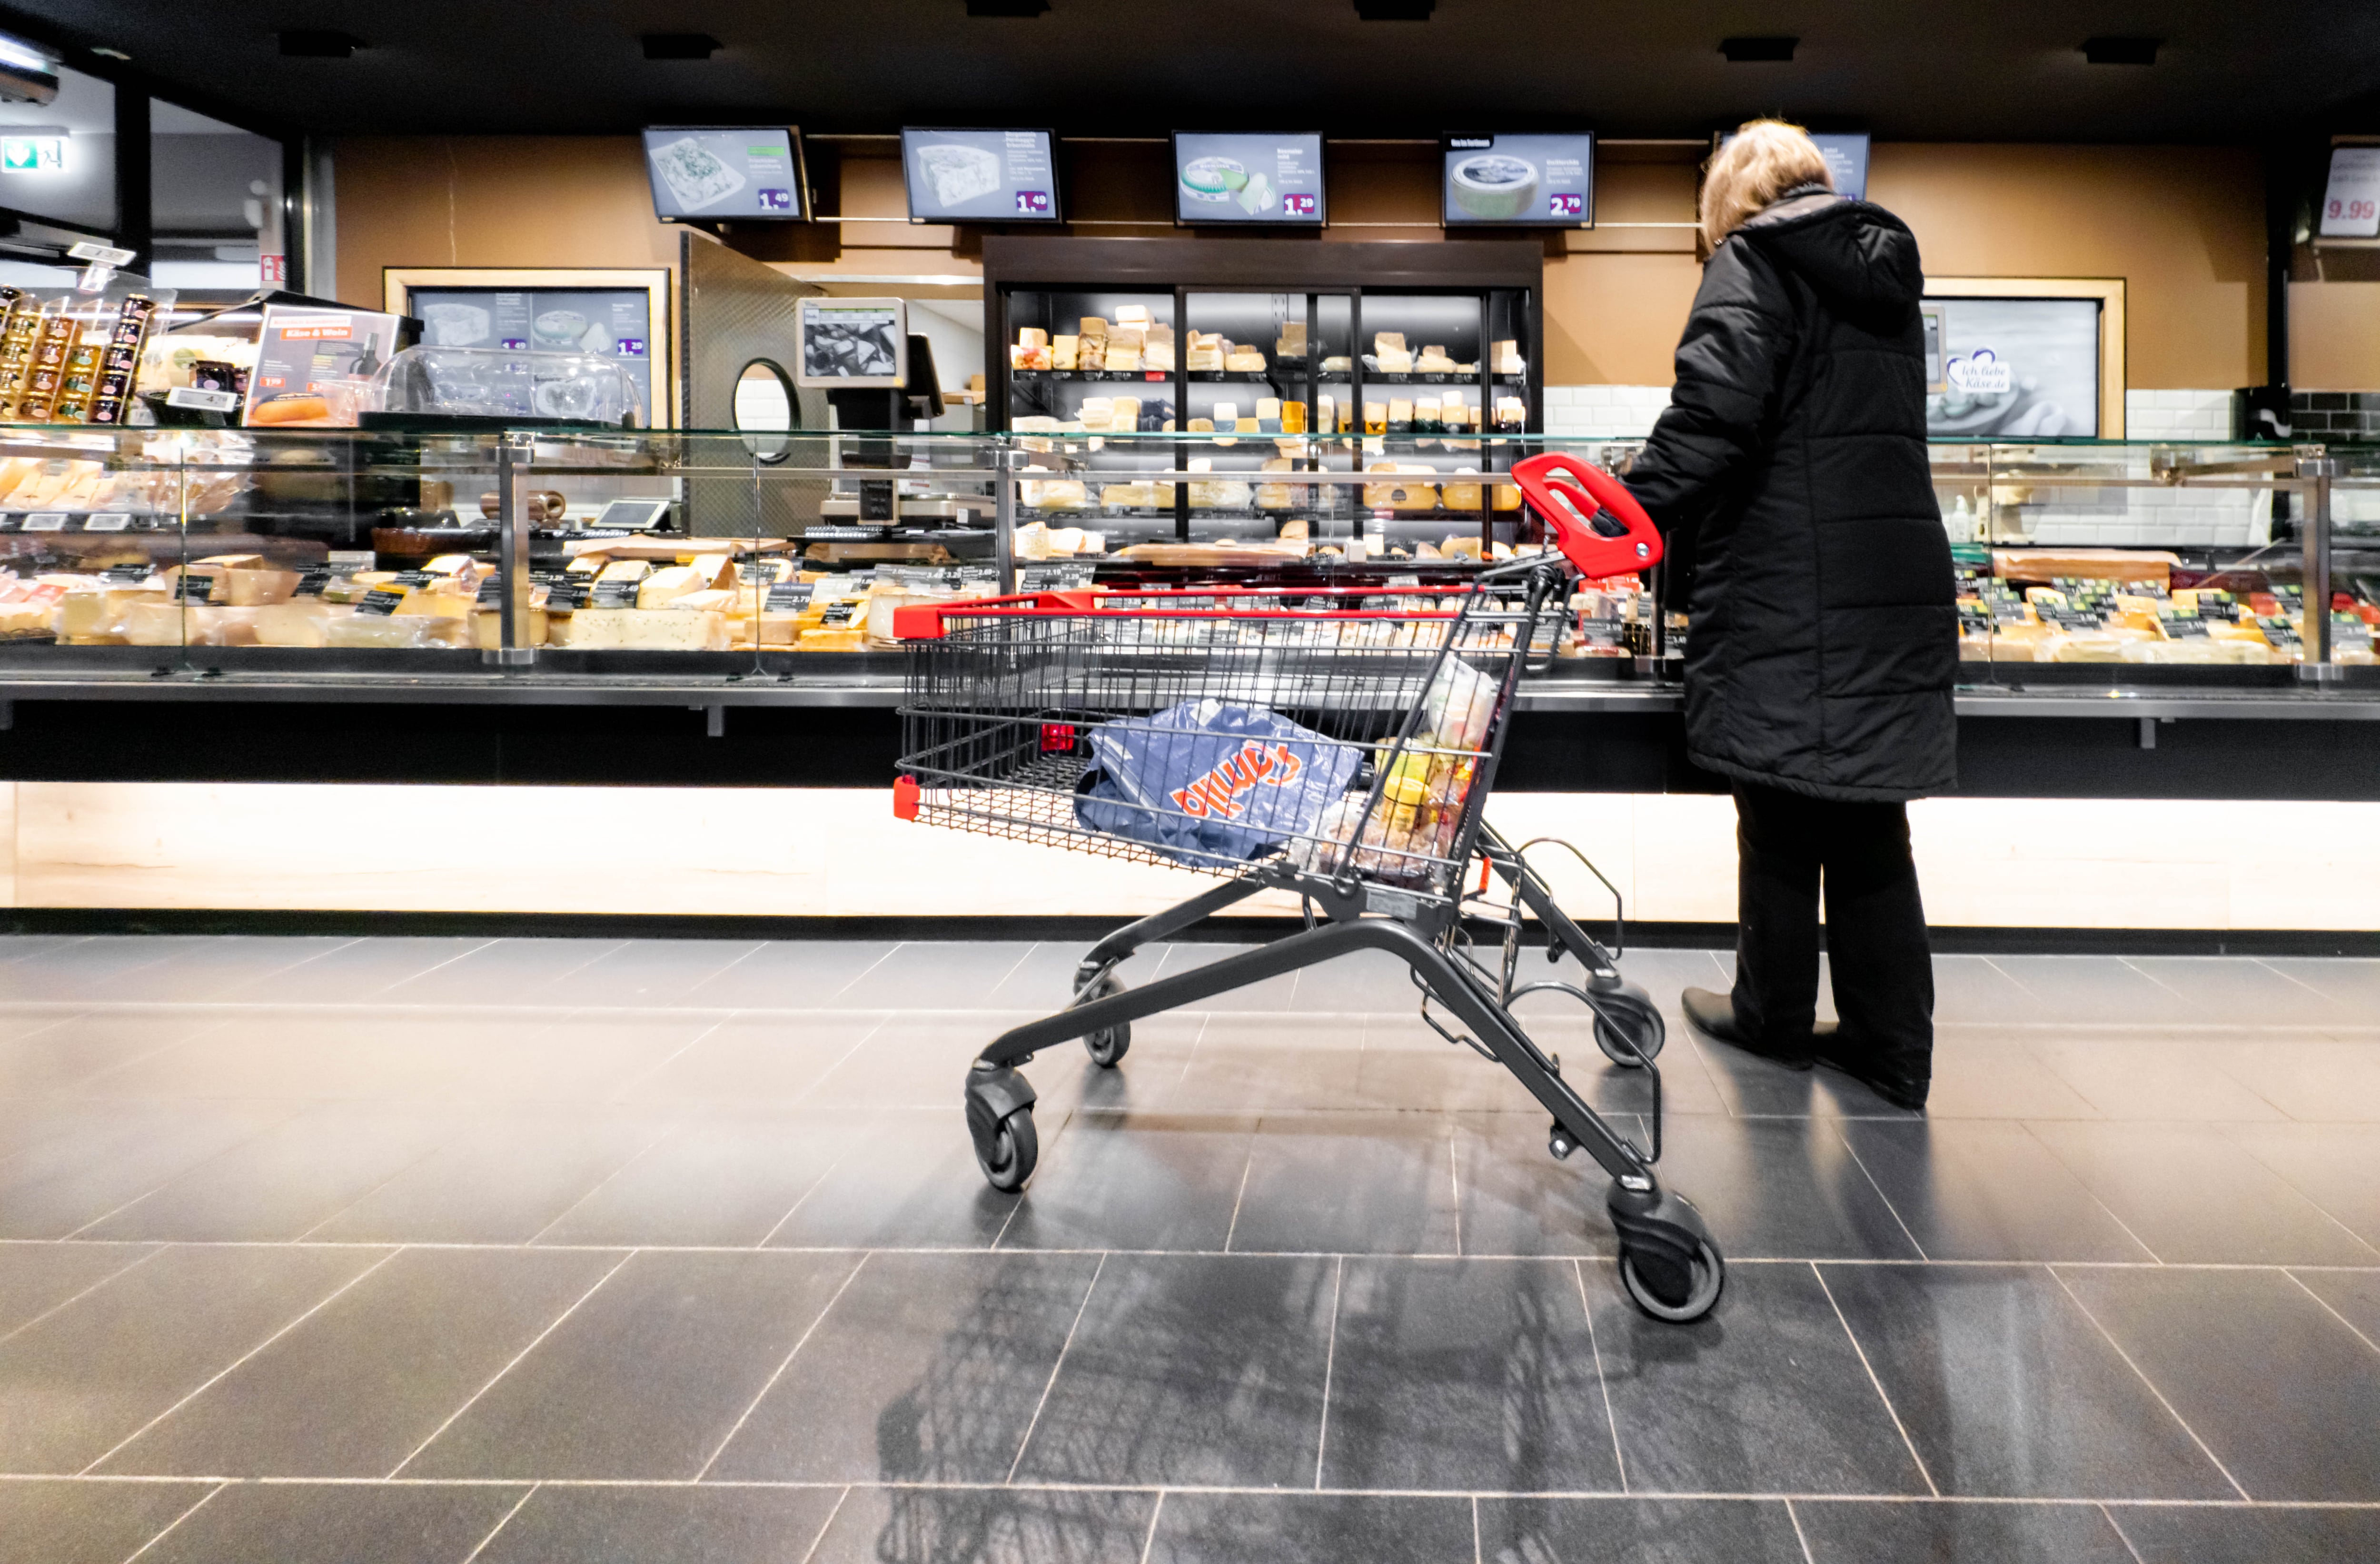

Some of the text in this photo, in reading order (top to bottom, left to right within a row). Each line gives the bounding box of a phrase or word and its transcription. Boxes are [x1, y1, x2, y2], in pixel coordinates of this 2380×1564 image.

[760, 193, 788, 209] 1.49
[1017, 195, 1046, 212] 1.49
[1285, 198, 1314, 215] 1.29
[1550, 197, 1581, 216] 2.79
[2329, 199, 2374, 219] 9.99
[619, 340, 643, 356] 1.29
[1962, 365, 2006, 376] Ich liebe
[1966, 377, 2005, 388] Käse.de
